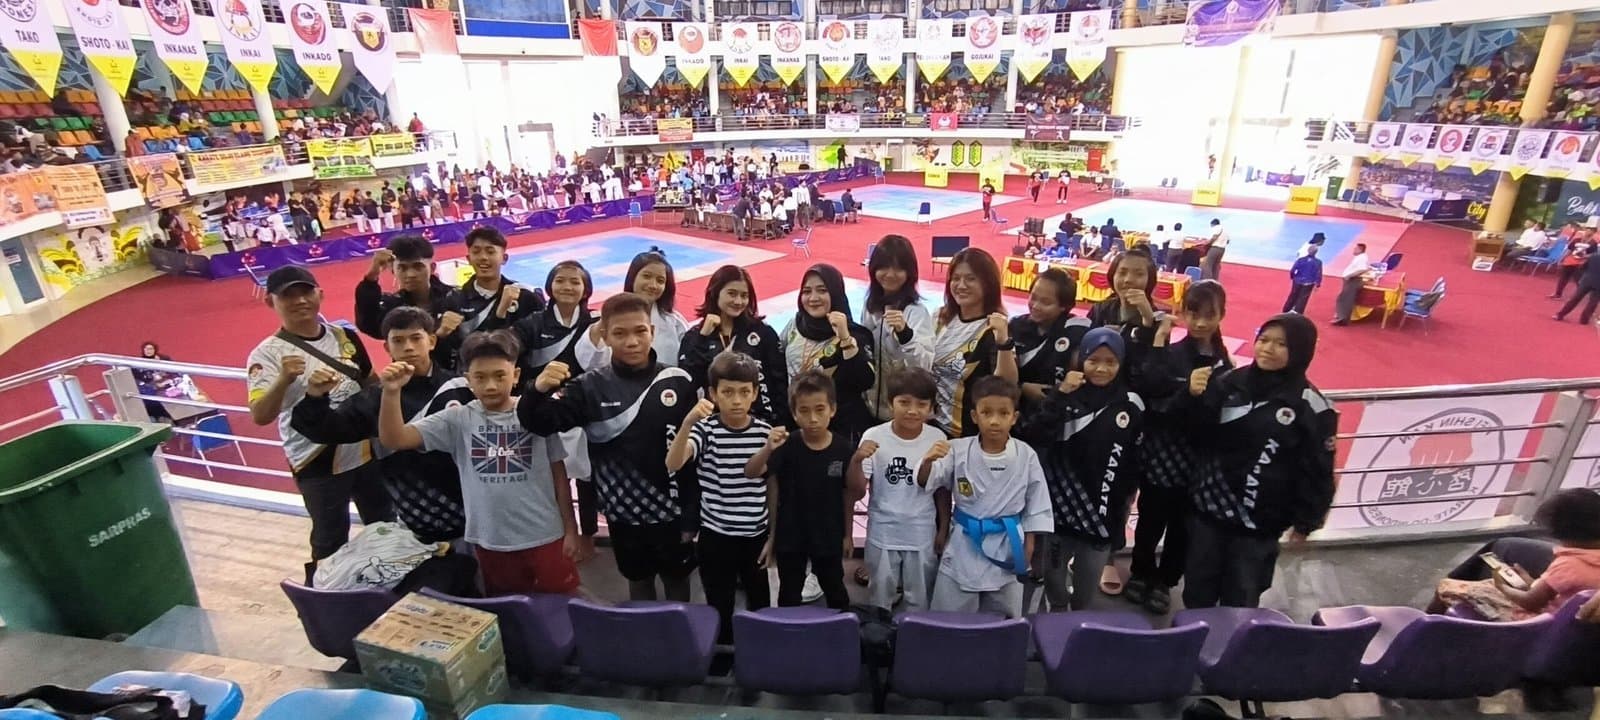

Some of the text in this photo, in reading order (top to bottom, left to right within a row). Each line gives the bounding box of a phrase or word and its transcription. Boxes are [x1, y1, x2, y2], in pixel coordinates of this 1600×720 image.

[15, 29, 39, 43] TAKO
[81, 36, 110, 49] SHOTO
[116, 39, 130, 50] KAI
[163, 43, 197, 55] INKANAS
[240, 48, 261, 57] INKAI
[302, 52, 332, 60] INKADO
[1467, 201, 1486, 219] City
[478, 424, 517, 433] BRITIS
[1099, 443, 1123, 516] KARATE
[88, 507, 151, 547] SARPRAS
